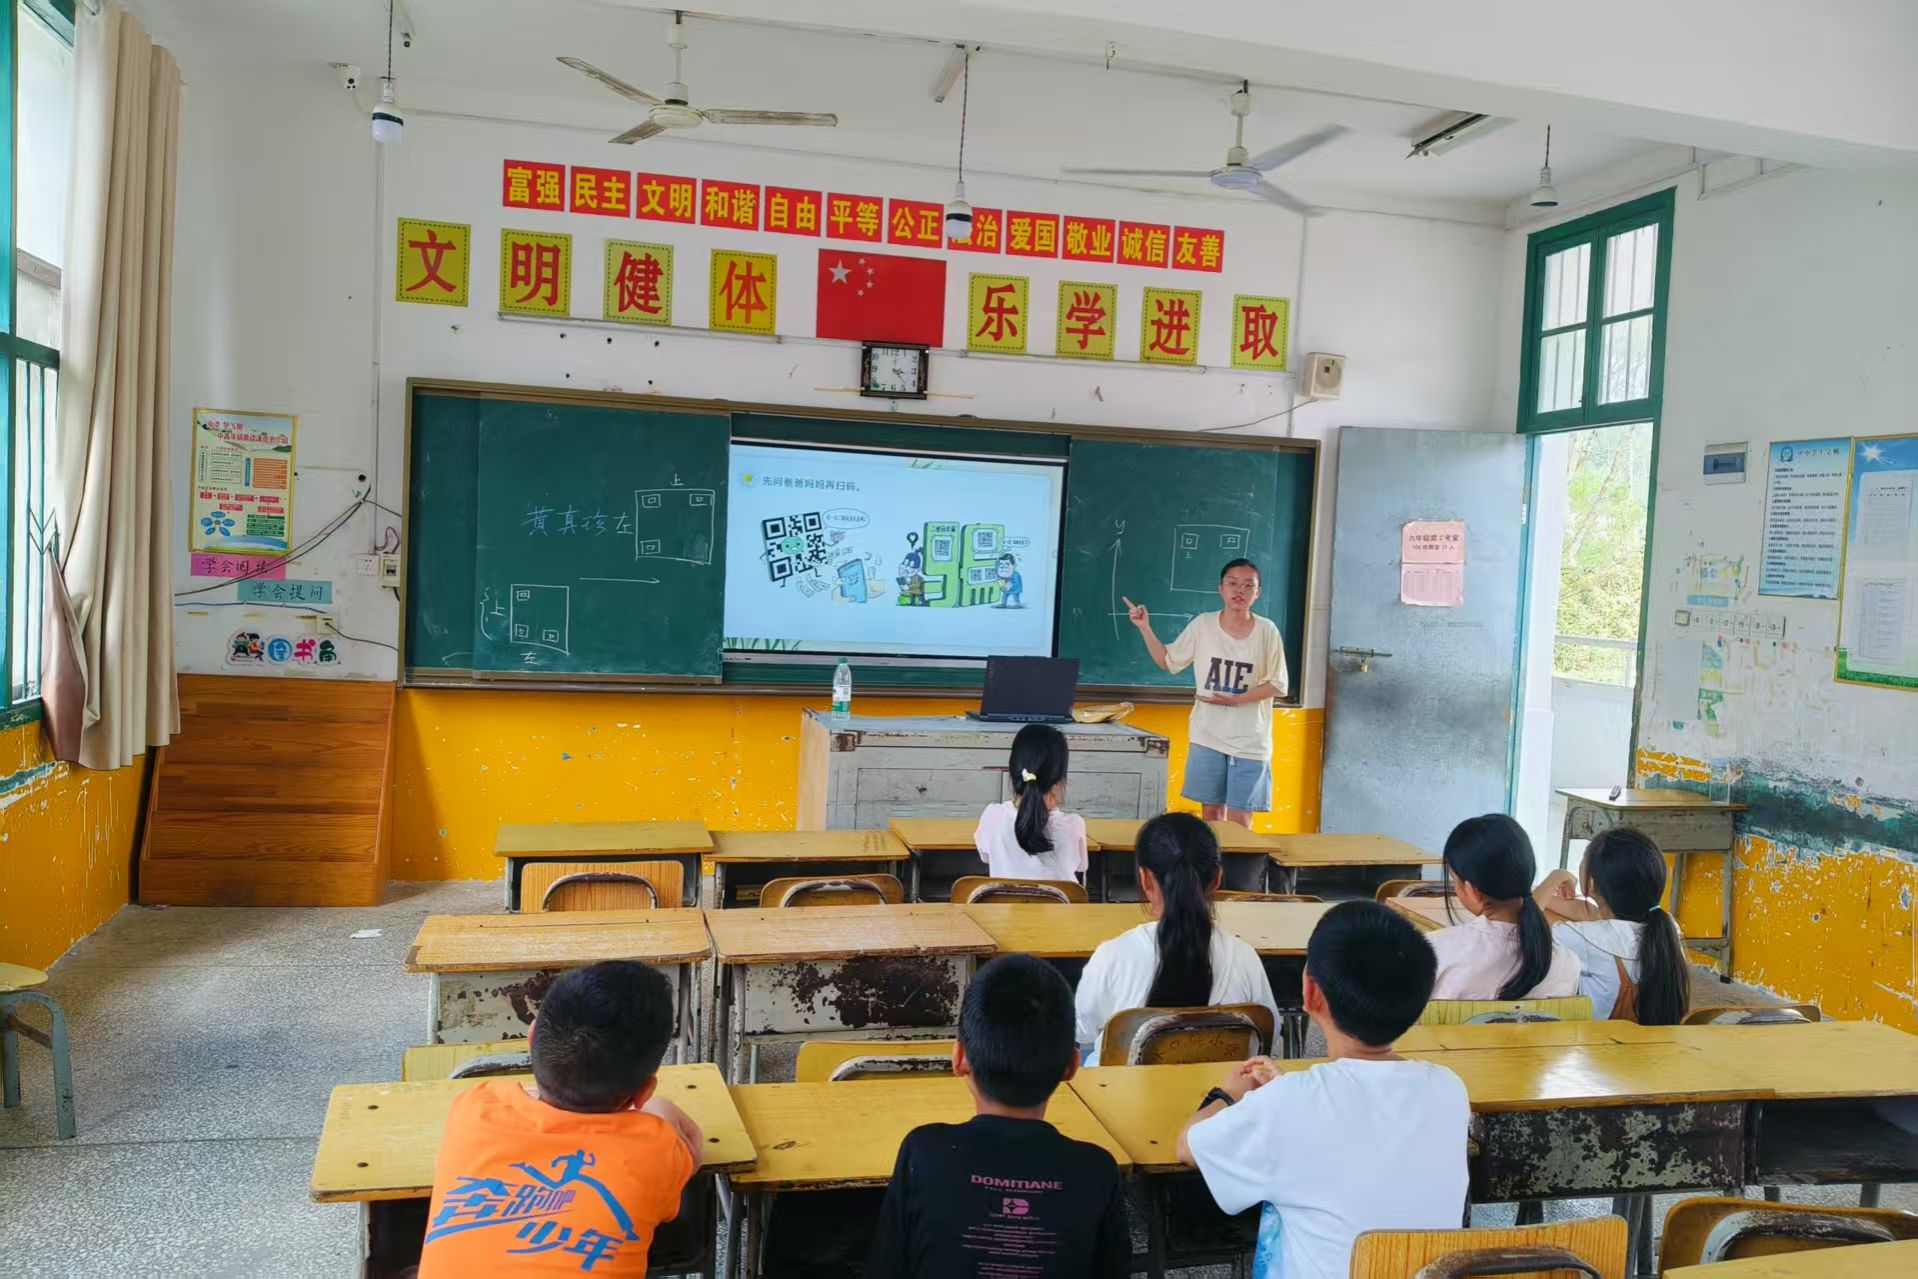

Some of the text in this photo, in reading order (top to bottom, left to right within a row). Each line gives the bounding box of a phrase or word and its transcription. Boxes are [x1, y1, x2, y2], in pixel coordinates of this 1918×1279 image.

[508, 167, 560, 204] 富强
[576, 174, 625, 209] 民主
[642, 180, 692, 217] 文明
[706, 187, 754, 224] 和谐
[771, 194, 815, 230] 自由
[831, 201, 878, 236] 平等
[893, 208, 939, 240] 公正
[1011, 218, 1055, 252] 爱国
[1067, 223, 1110, 256] 敬业
[1122, 228, 1166, 262] 诚信
[1176, 233, 1220, 267] 友善
[405, 229, 1280, 361] 文 明 健 体 乐 学 进 取
[669, 472, 685, 487] 上
[762, 475, 861, 493] 先问爸爸妈妈再扫码。
[613, 511, 635, 536] 左
[253, 581, 323, 601] 学会提问
[1204, 657, 1254, 694] AIE
[970, 1174, 1064, 1190] DOMITIANE
[506, 1221, 624, 1271] 少年
